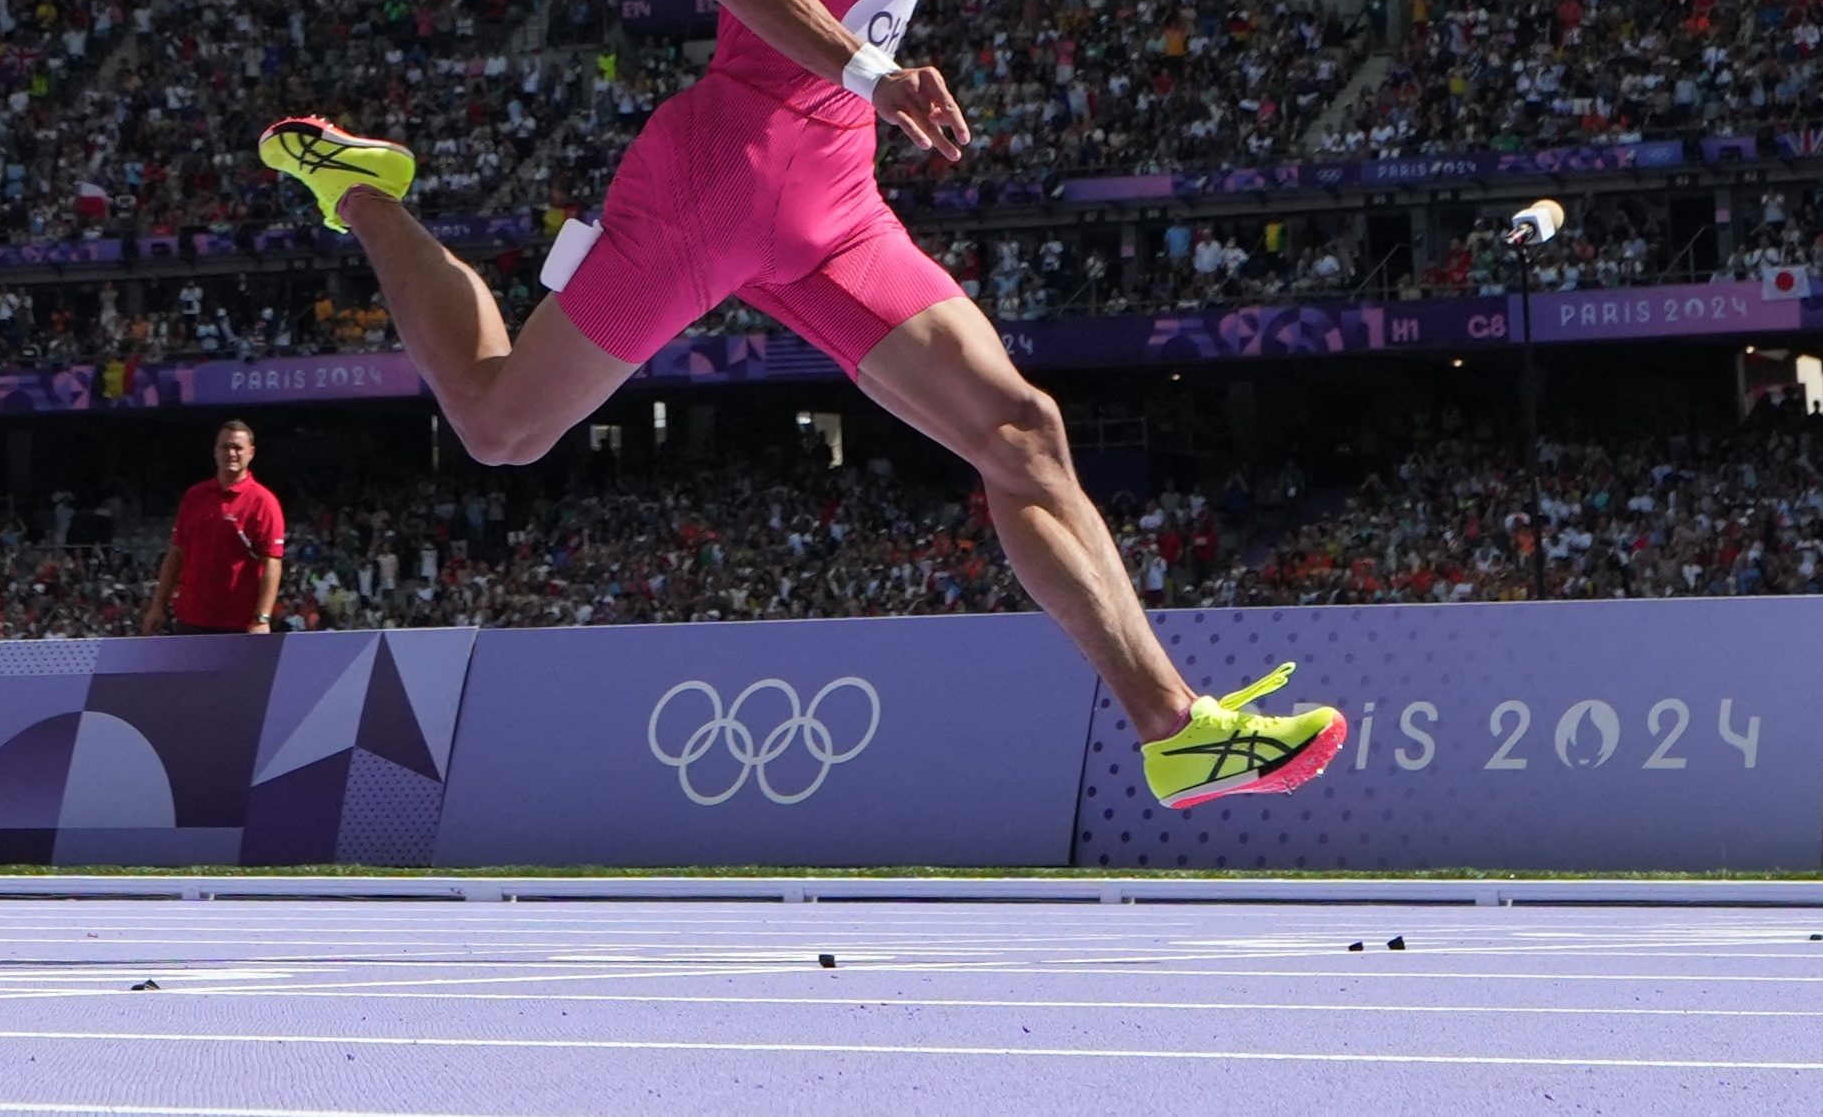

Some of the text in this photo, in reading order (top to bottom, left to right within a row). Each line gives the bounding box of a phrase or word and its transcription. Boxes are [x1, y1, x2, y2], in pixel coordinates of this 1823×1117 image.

[1560, 296, 1747, 327] PARIS 2024
[1392, 317, 1419, 342] H1
[1003, 334, 1034, 355] 24
[231, 366, 382, 390] PARIS 2024
[1483, 697, 1762, 771] 2024
